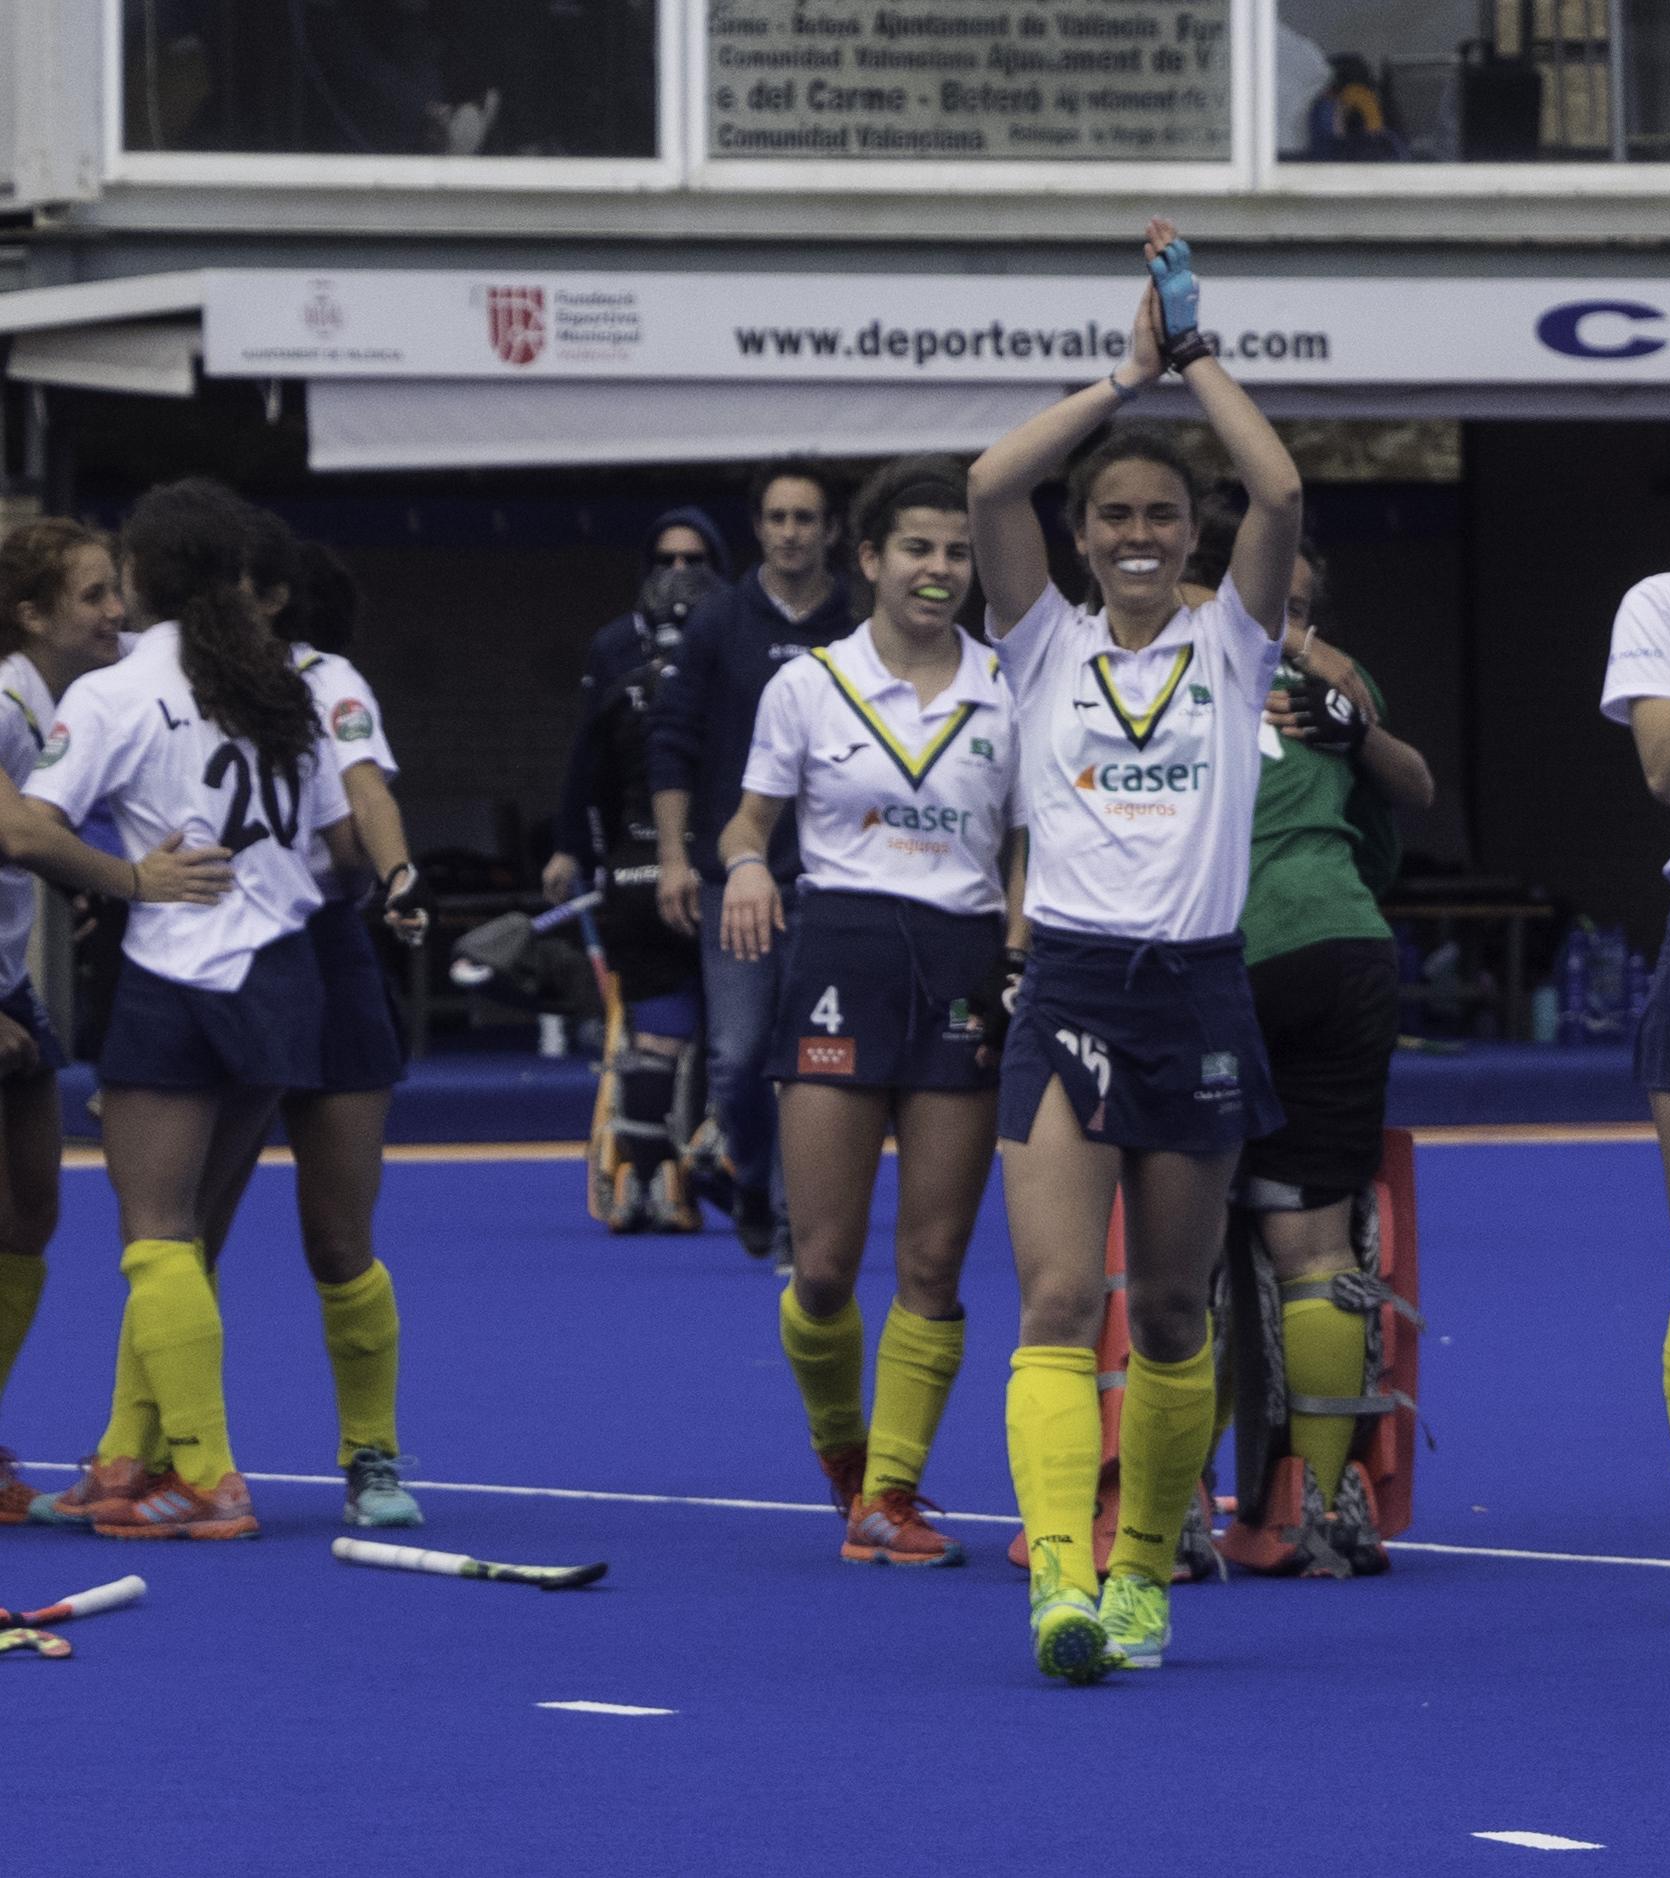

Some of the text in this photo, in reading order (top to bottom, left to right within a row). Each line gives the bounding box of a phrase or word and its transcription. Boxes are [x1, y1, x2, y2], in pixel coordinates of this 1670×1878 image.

[734, 319, 1329, 364] www.deportevalea.com
[1100, 762, 1209, 792] caser
[203, 741, 300, 852] 20
[1104, 800, 1177, 821] seguros
[883, 804, 973, 836] caser
[888, 837, 950, 856] seguros
[810, 985, 844, 1034] 4
